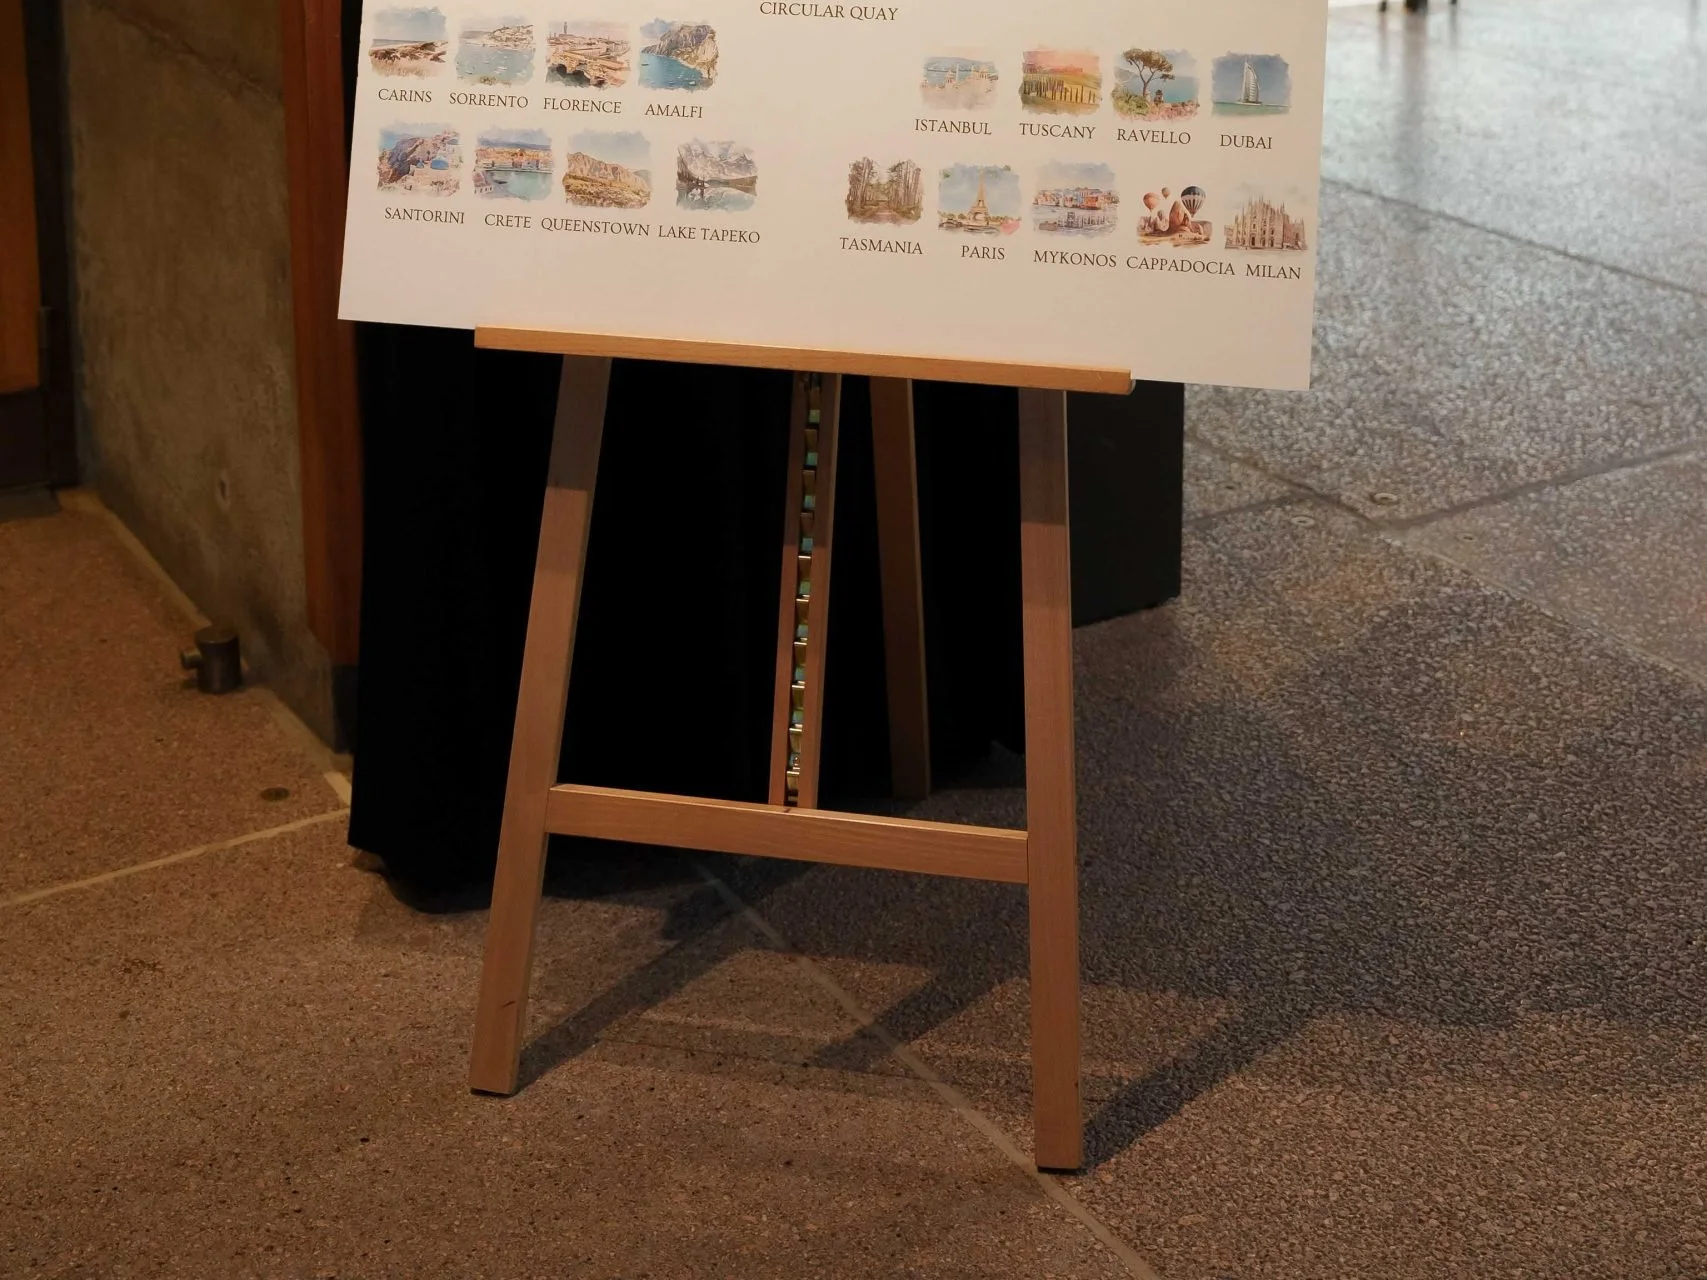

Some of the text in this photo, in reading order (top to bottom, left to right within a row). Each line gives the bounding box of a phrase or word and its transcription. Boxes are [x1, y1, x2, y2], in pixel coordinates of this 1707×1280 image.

[759, 1, 899, 21] CIRCULAR QUAY
[378, 88, 432, 103] CARINS
[449, 92, 529, 109] SORRENTO
[543, 97, 622, 114] FLORENCE
[645, 103, 703, 119] AMALFI
[914, 118, 992, 136] ISTANBUL
[1019, 122, 1096, 140] TUSCANY
[1116, 128, 1191, 145] RAVELLO
[1220, 134, 1273, 150] DUBAI
[384, 206, 465, 224] SANTORINI
[484, 213, 532, 229] CRETE
[541, 217, 650, 237] QUEENSTOWN
[658, 225, 761, 244] LAKE TAPEKO
[839, 237, 923, 255] TASMANIA
[961, 244, 1006, 260] PARIS
[1033, 249, 1117, 269] MYKONOS
[1126, 256, 1236, 276] CAPPADOCIA
[1245, 263, 1301, 280] MILAN
